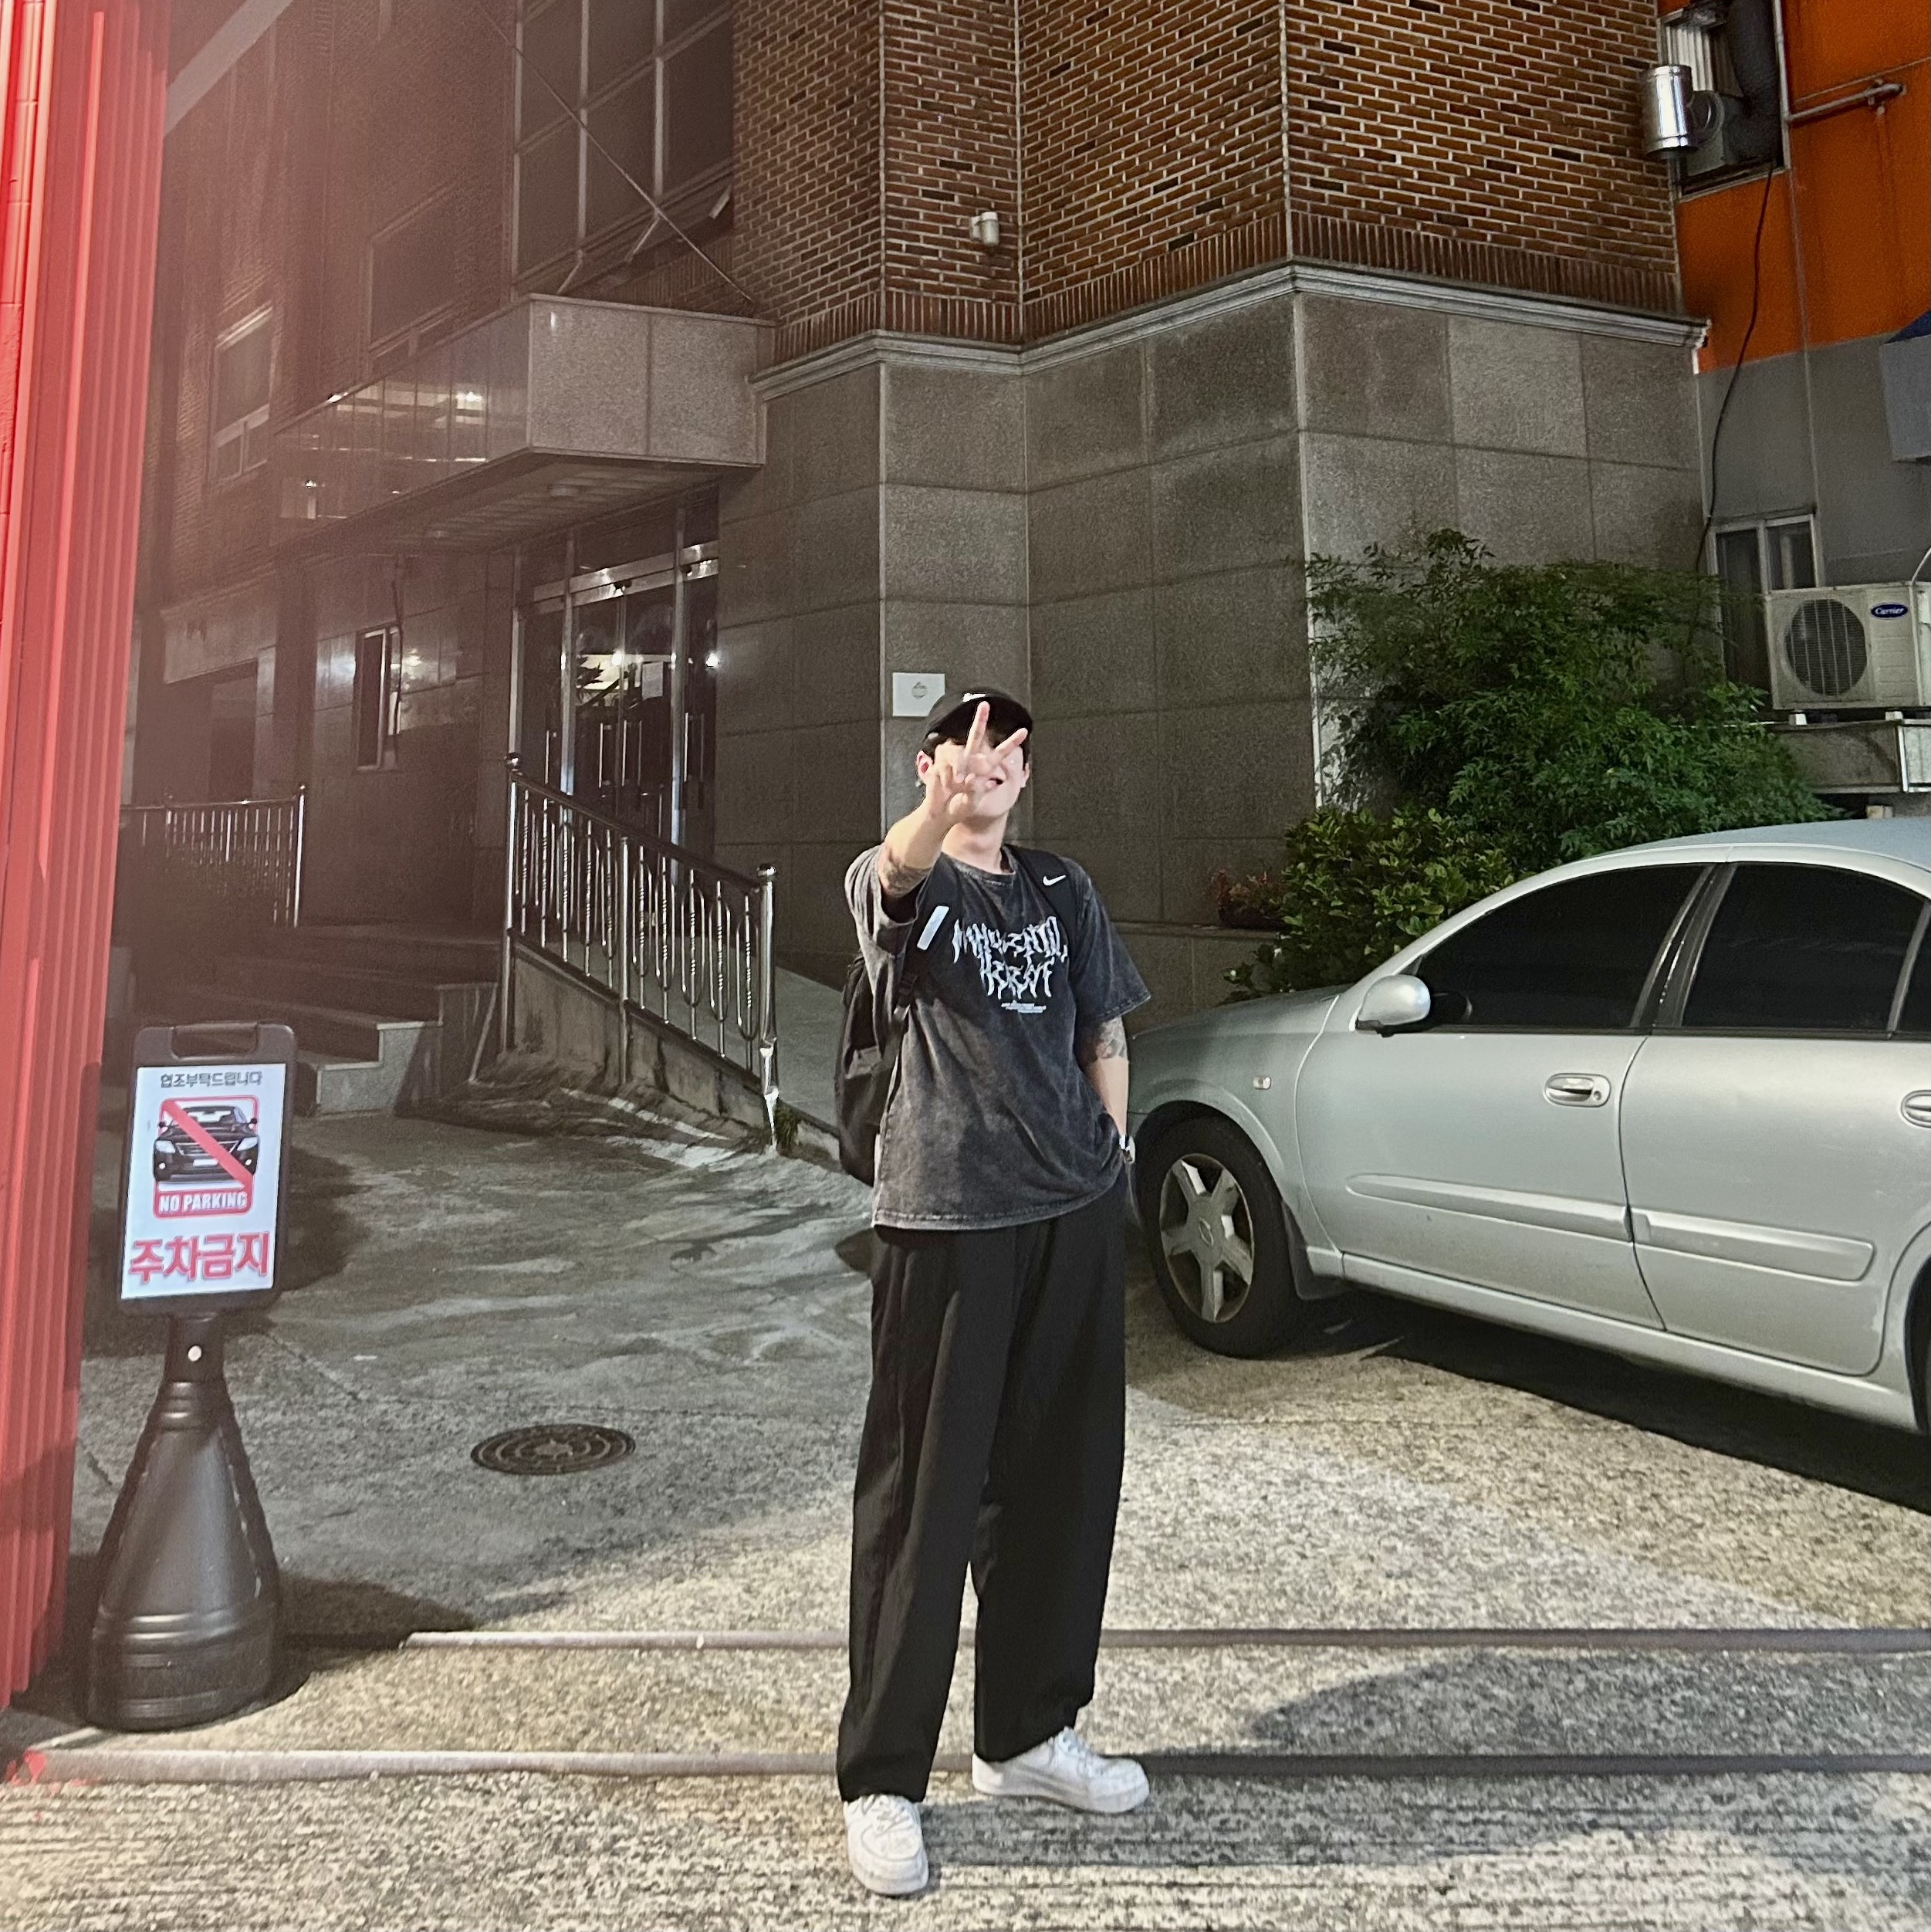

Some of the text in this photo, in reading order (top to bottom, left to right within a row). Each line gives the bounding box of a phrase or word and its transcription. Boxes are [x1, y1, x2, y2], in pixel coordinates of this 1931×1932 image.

[159, 1191, 247, 1213] NO PARKING
[129, 1231, 270, 1284] 주차금지
